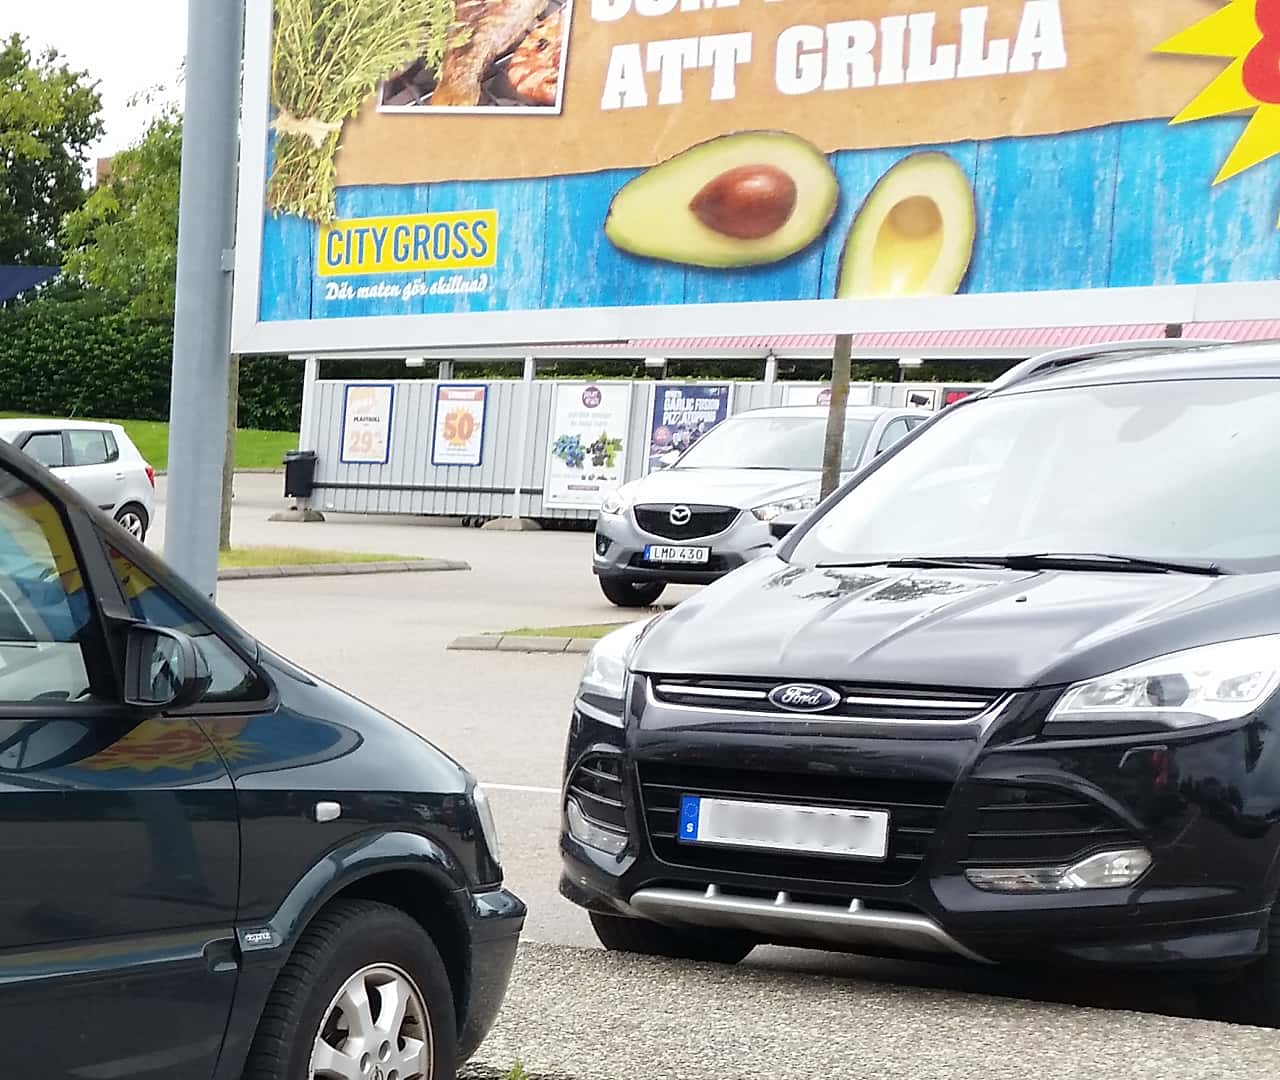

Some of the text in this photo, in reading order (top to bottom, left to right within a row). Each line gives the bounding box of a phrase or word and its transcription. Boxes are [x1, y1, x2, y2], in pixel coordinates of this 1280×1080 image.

[601, 0, 1067, 110] ATT GRILLA
[327, 220, 488, 266] CITY GROSS
[356, 282, 402, 299] maten
[401, 278, 429, 301] gör
[429, 273, 488, 295] skillnad
[443, 412, 474, 441] 50
[654, 547, 704, 560] LMD 430
[781, 686, 823, 705] Ford
[686, 822, 694, 833] S
